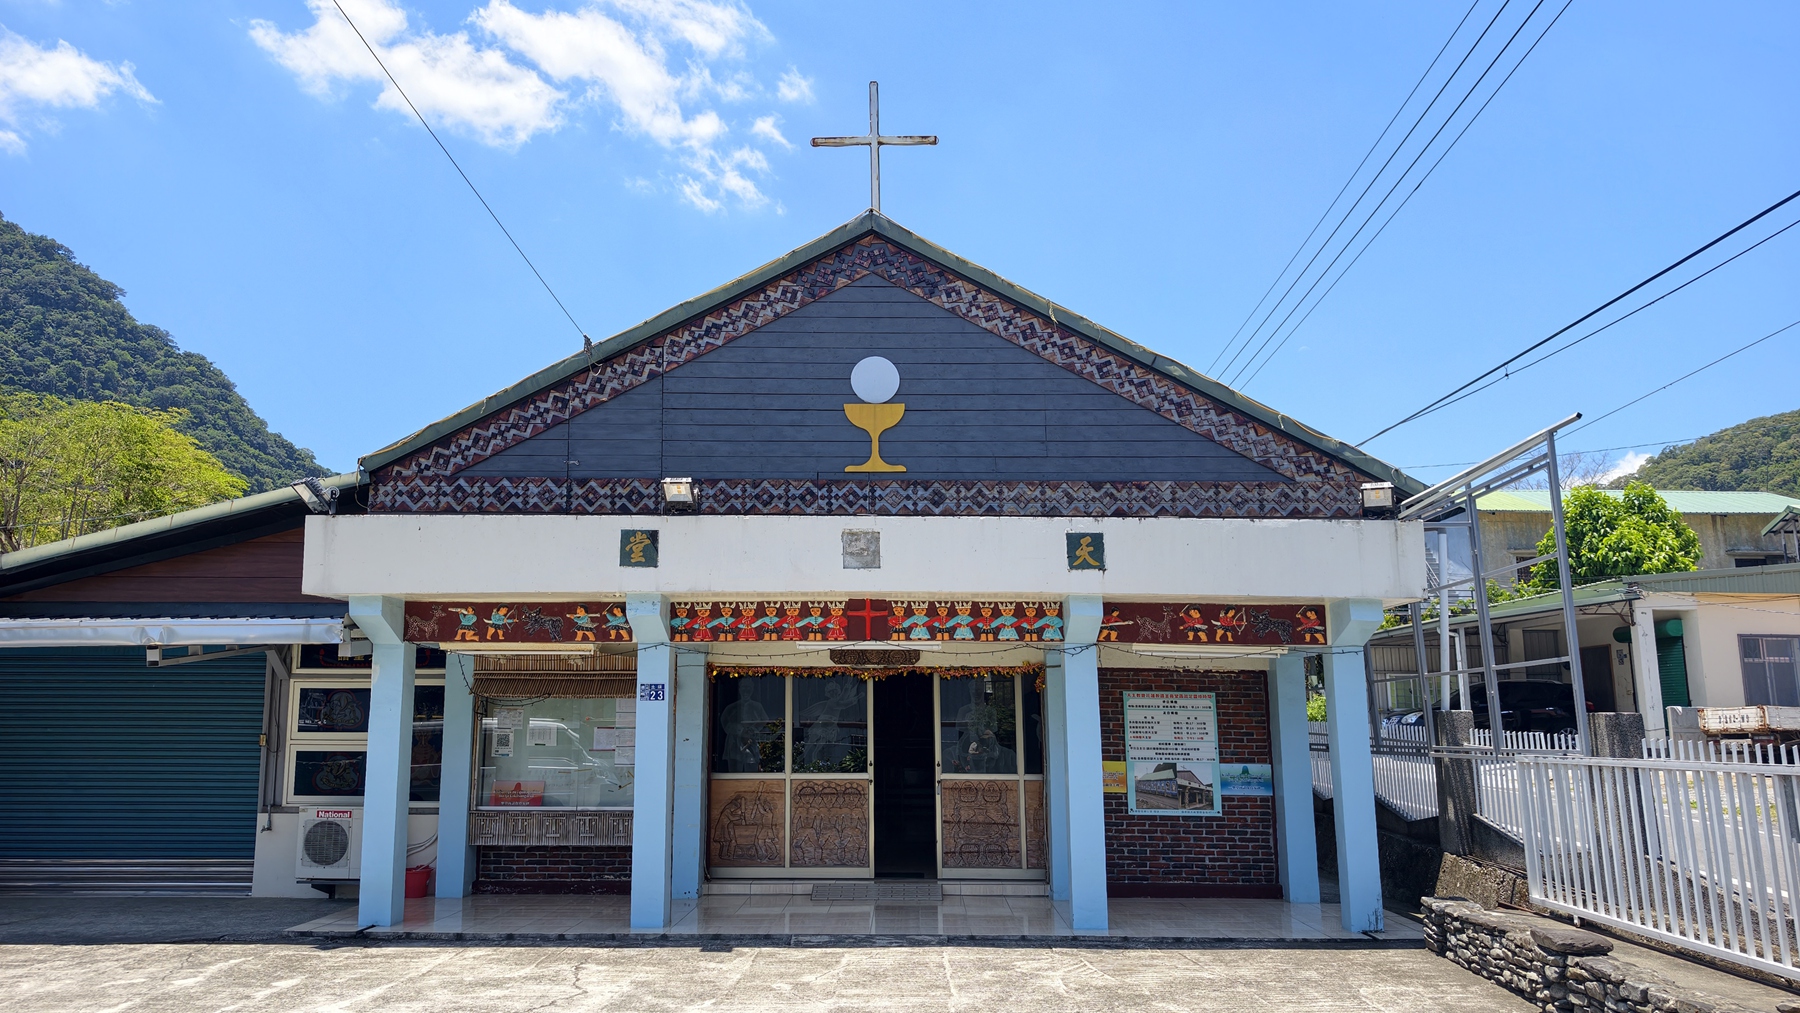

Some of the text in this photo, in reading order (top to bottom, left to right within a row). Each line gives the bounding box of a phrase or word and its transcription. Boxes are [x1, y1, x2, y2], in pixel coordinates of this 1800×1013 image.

[625, 531, 1101, 566] 天 堂
[650, 690, 664, 701] 23
